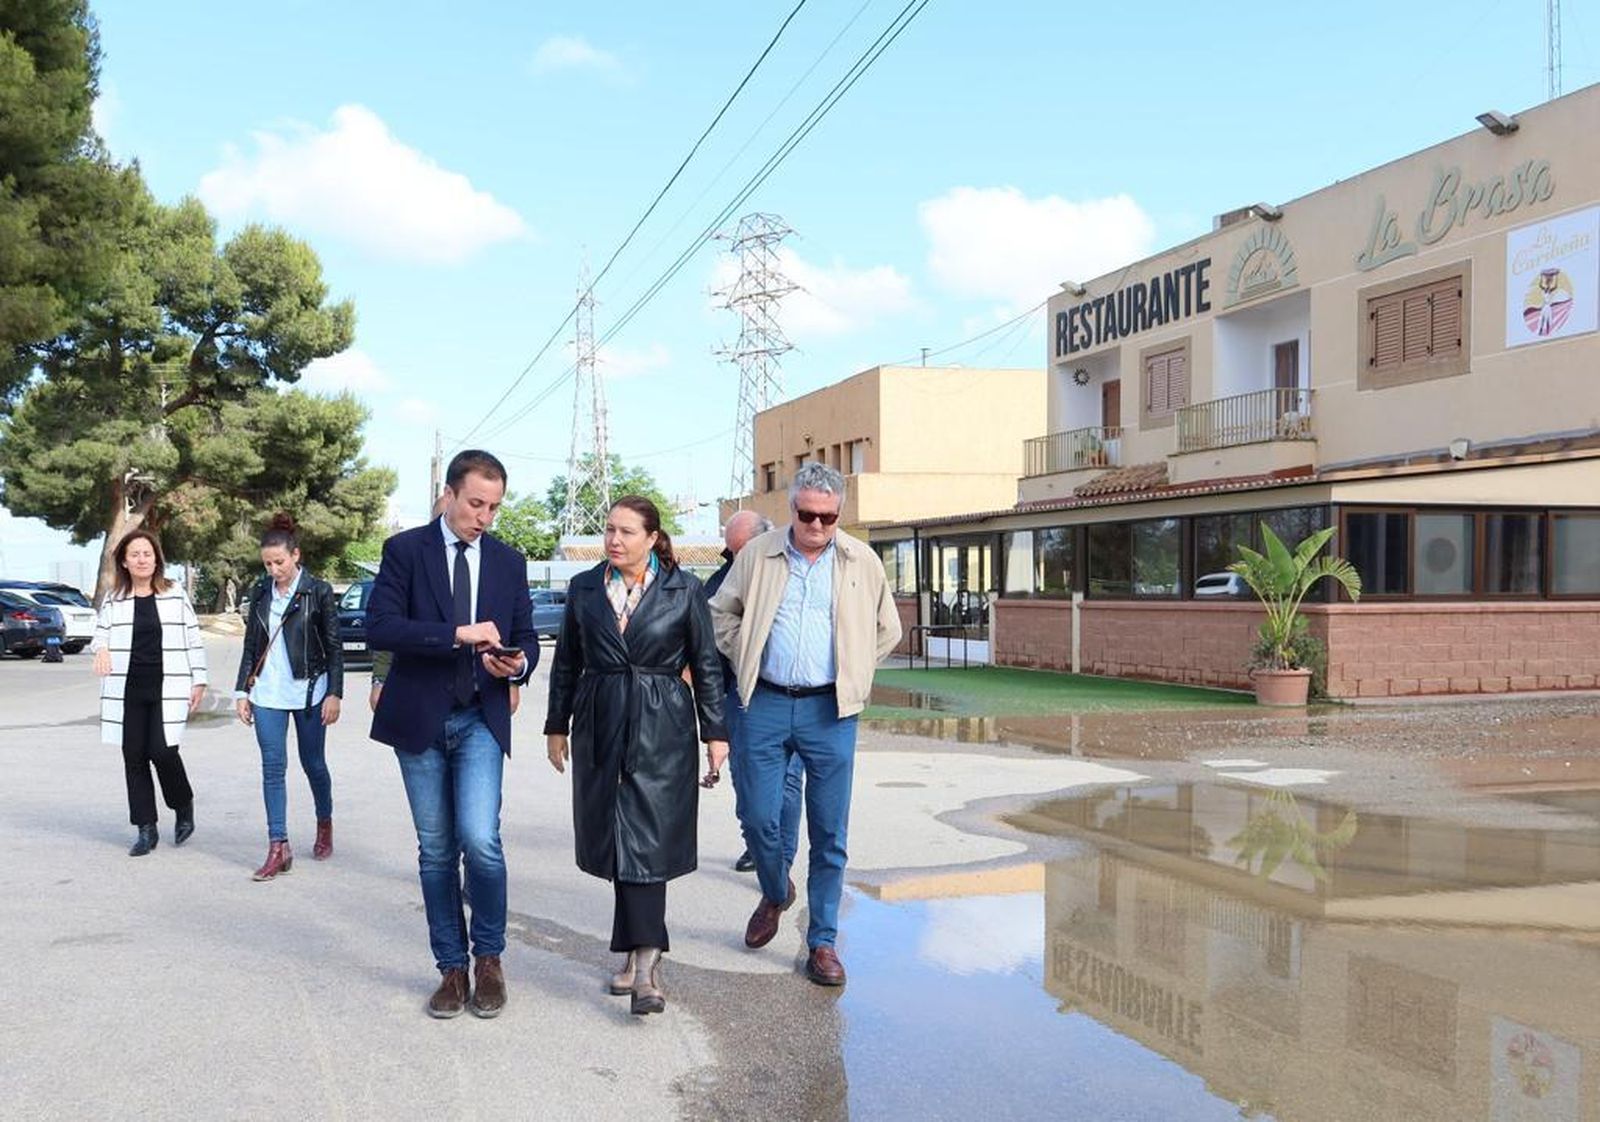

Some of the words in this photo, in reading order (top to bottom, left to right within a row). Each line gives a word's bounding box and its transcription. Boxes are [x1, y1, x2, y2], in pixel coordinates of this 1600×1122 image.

[1356, 194, 1418, 271] La
[1416, 160, 1556, 245] Brasa
[1056, 257, 1212, 357] RESTAURANTE
